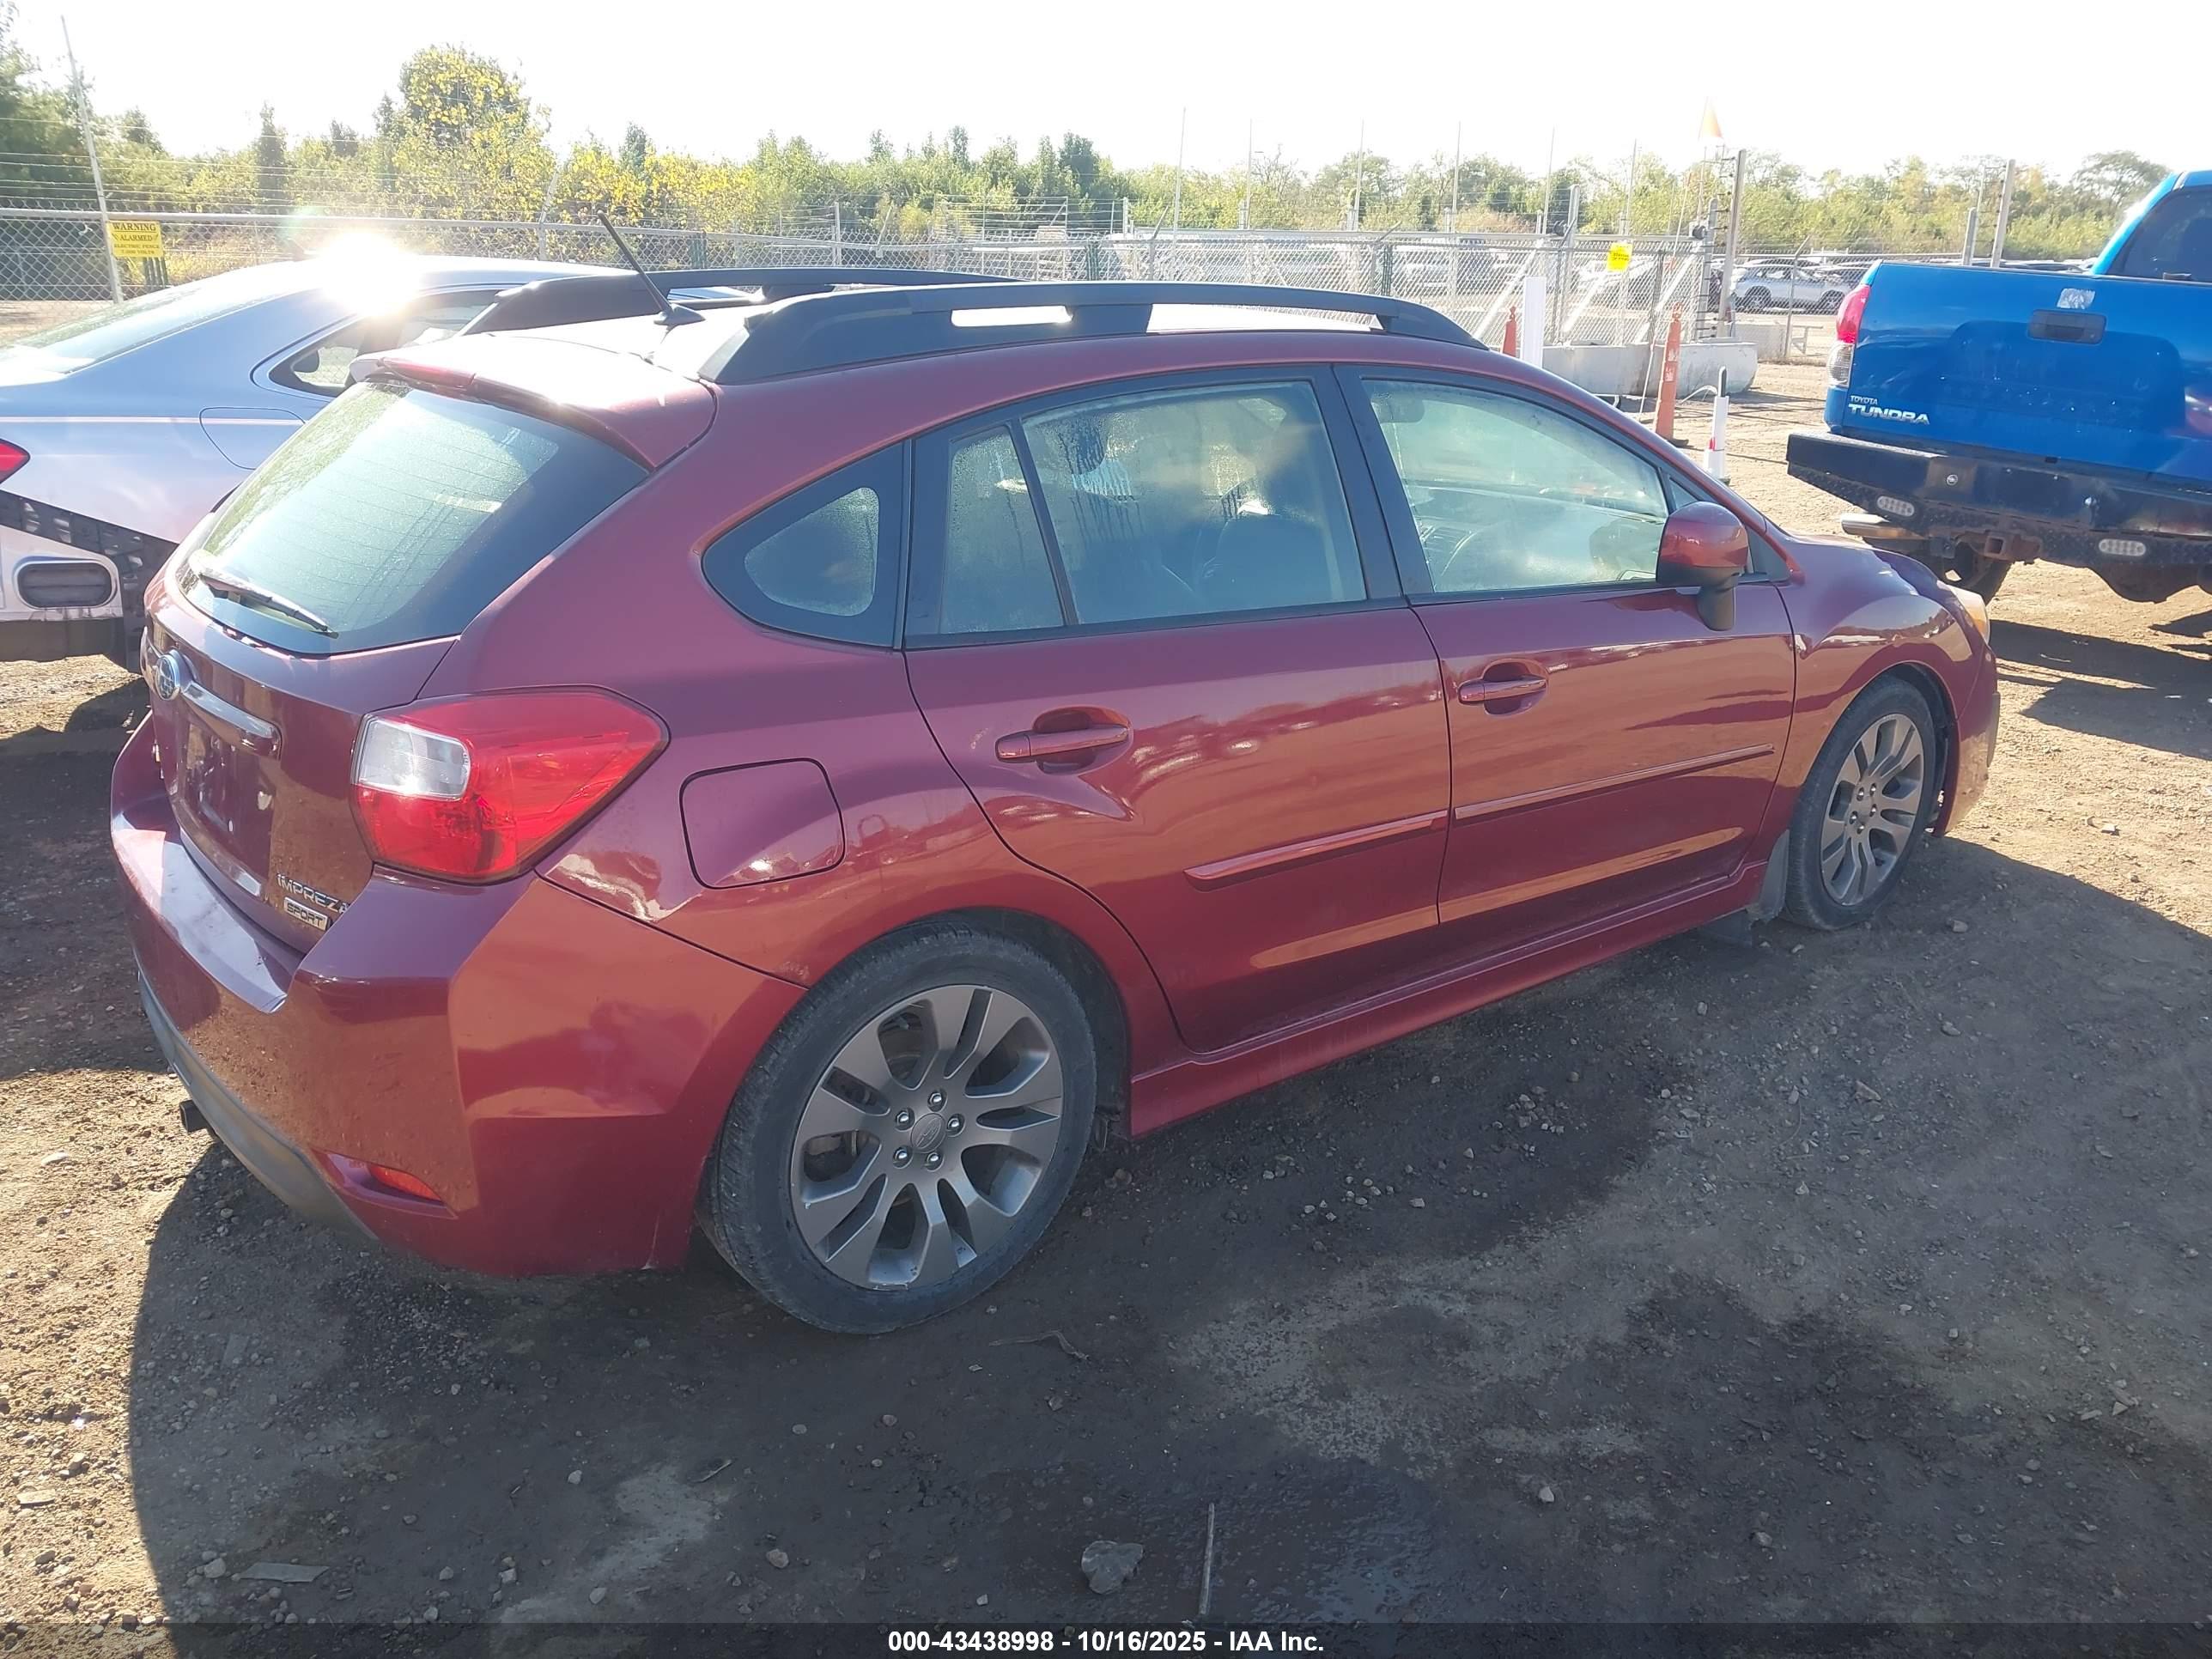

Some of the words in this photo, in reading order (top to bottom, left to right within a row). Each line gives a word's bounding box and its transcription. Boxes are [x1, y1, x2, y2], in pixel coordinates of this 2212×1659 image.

[112, 222, 156, 231] WARNING
[1850, 395, 1878, 405] TOYOTA
[1848, 404, 1930, 425] TUNDRA
[287, 902, 324, 927] SPORT
